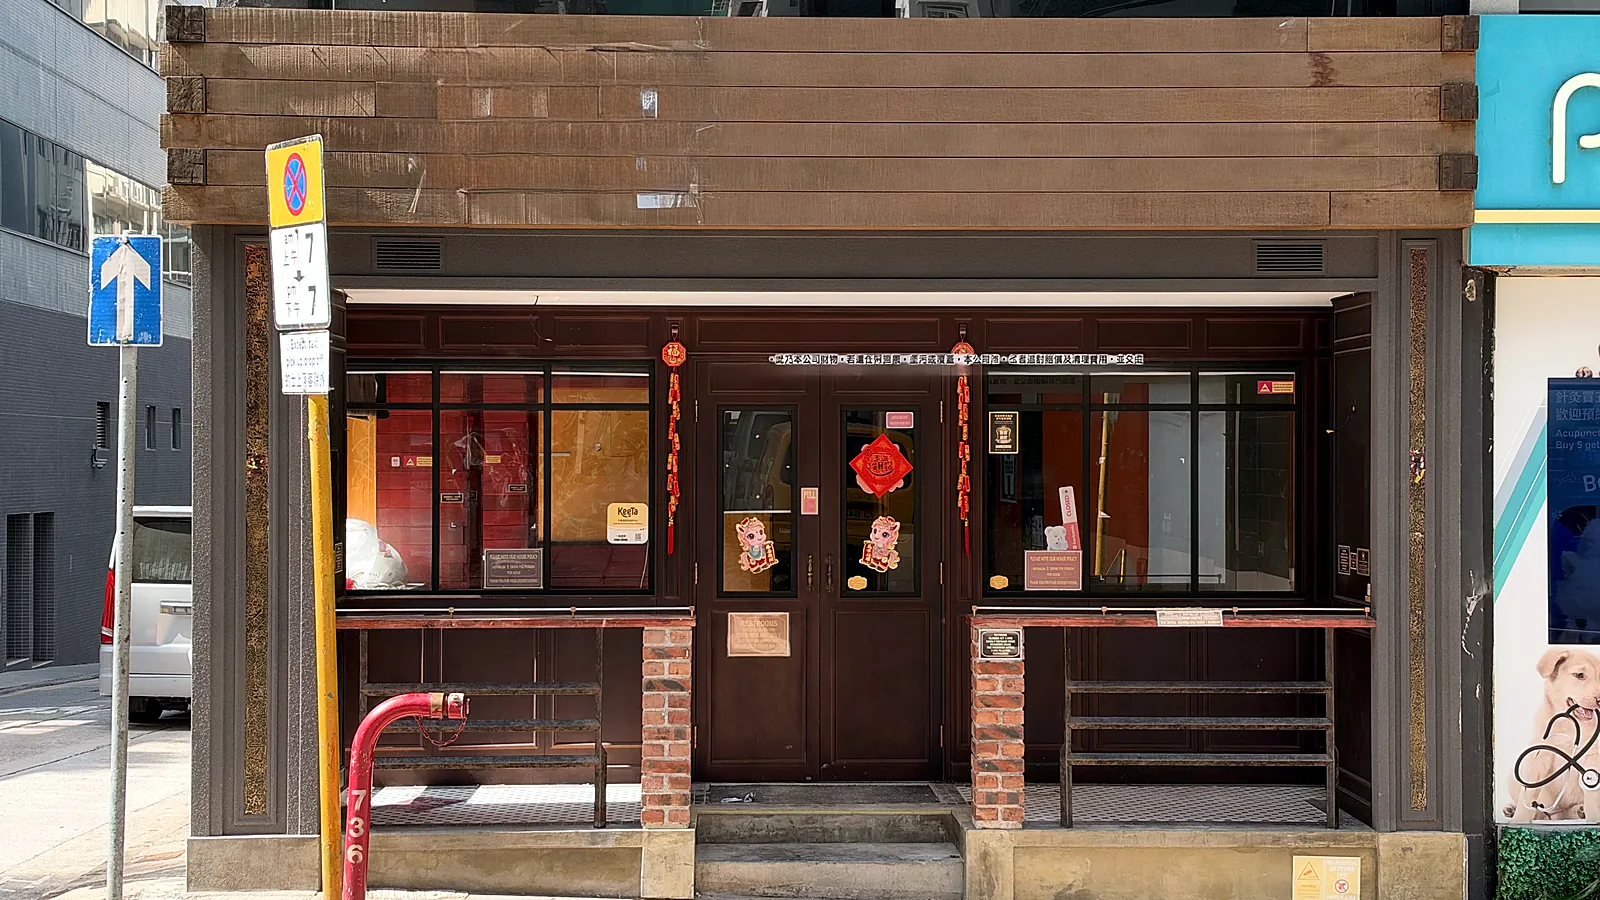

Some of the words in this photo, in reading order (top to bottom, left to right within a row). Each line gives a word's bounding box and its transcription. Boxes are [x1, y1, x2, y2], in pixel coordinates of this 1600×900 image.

[305, 233, 313, 263] 7
[308, 285, 316, 315] 7
[1556, 441, 1574, 451] Buy
[1577, 440, 1582, 449] 5
[804, 490, 816, 499] PULL
[617, 506, 639, 518] KeeTa
[741, 620, 778, 628] RESTROOMS
